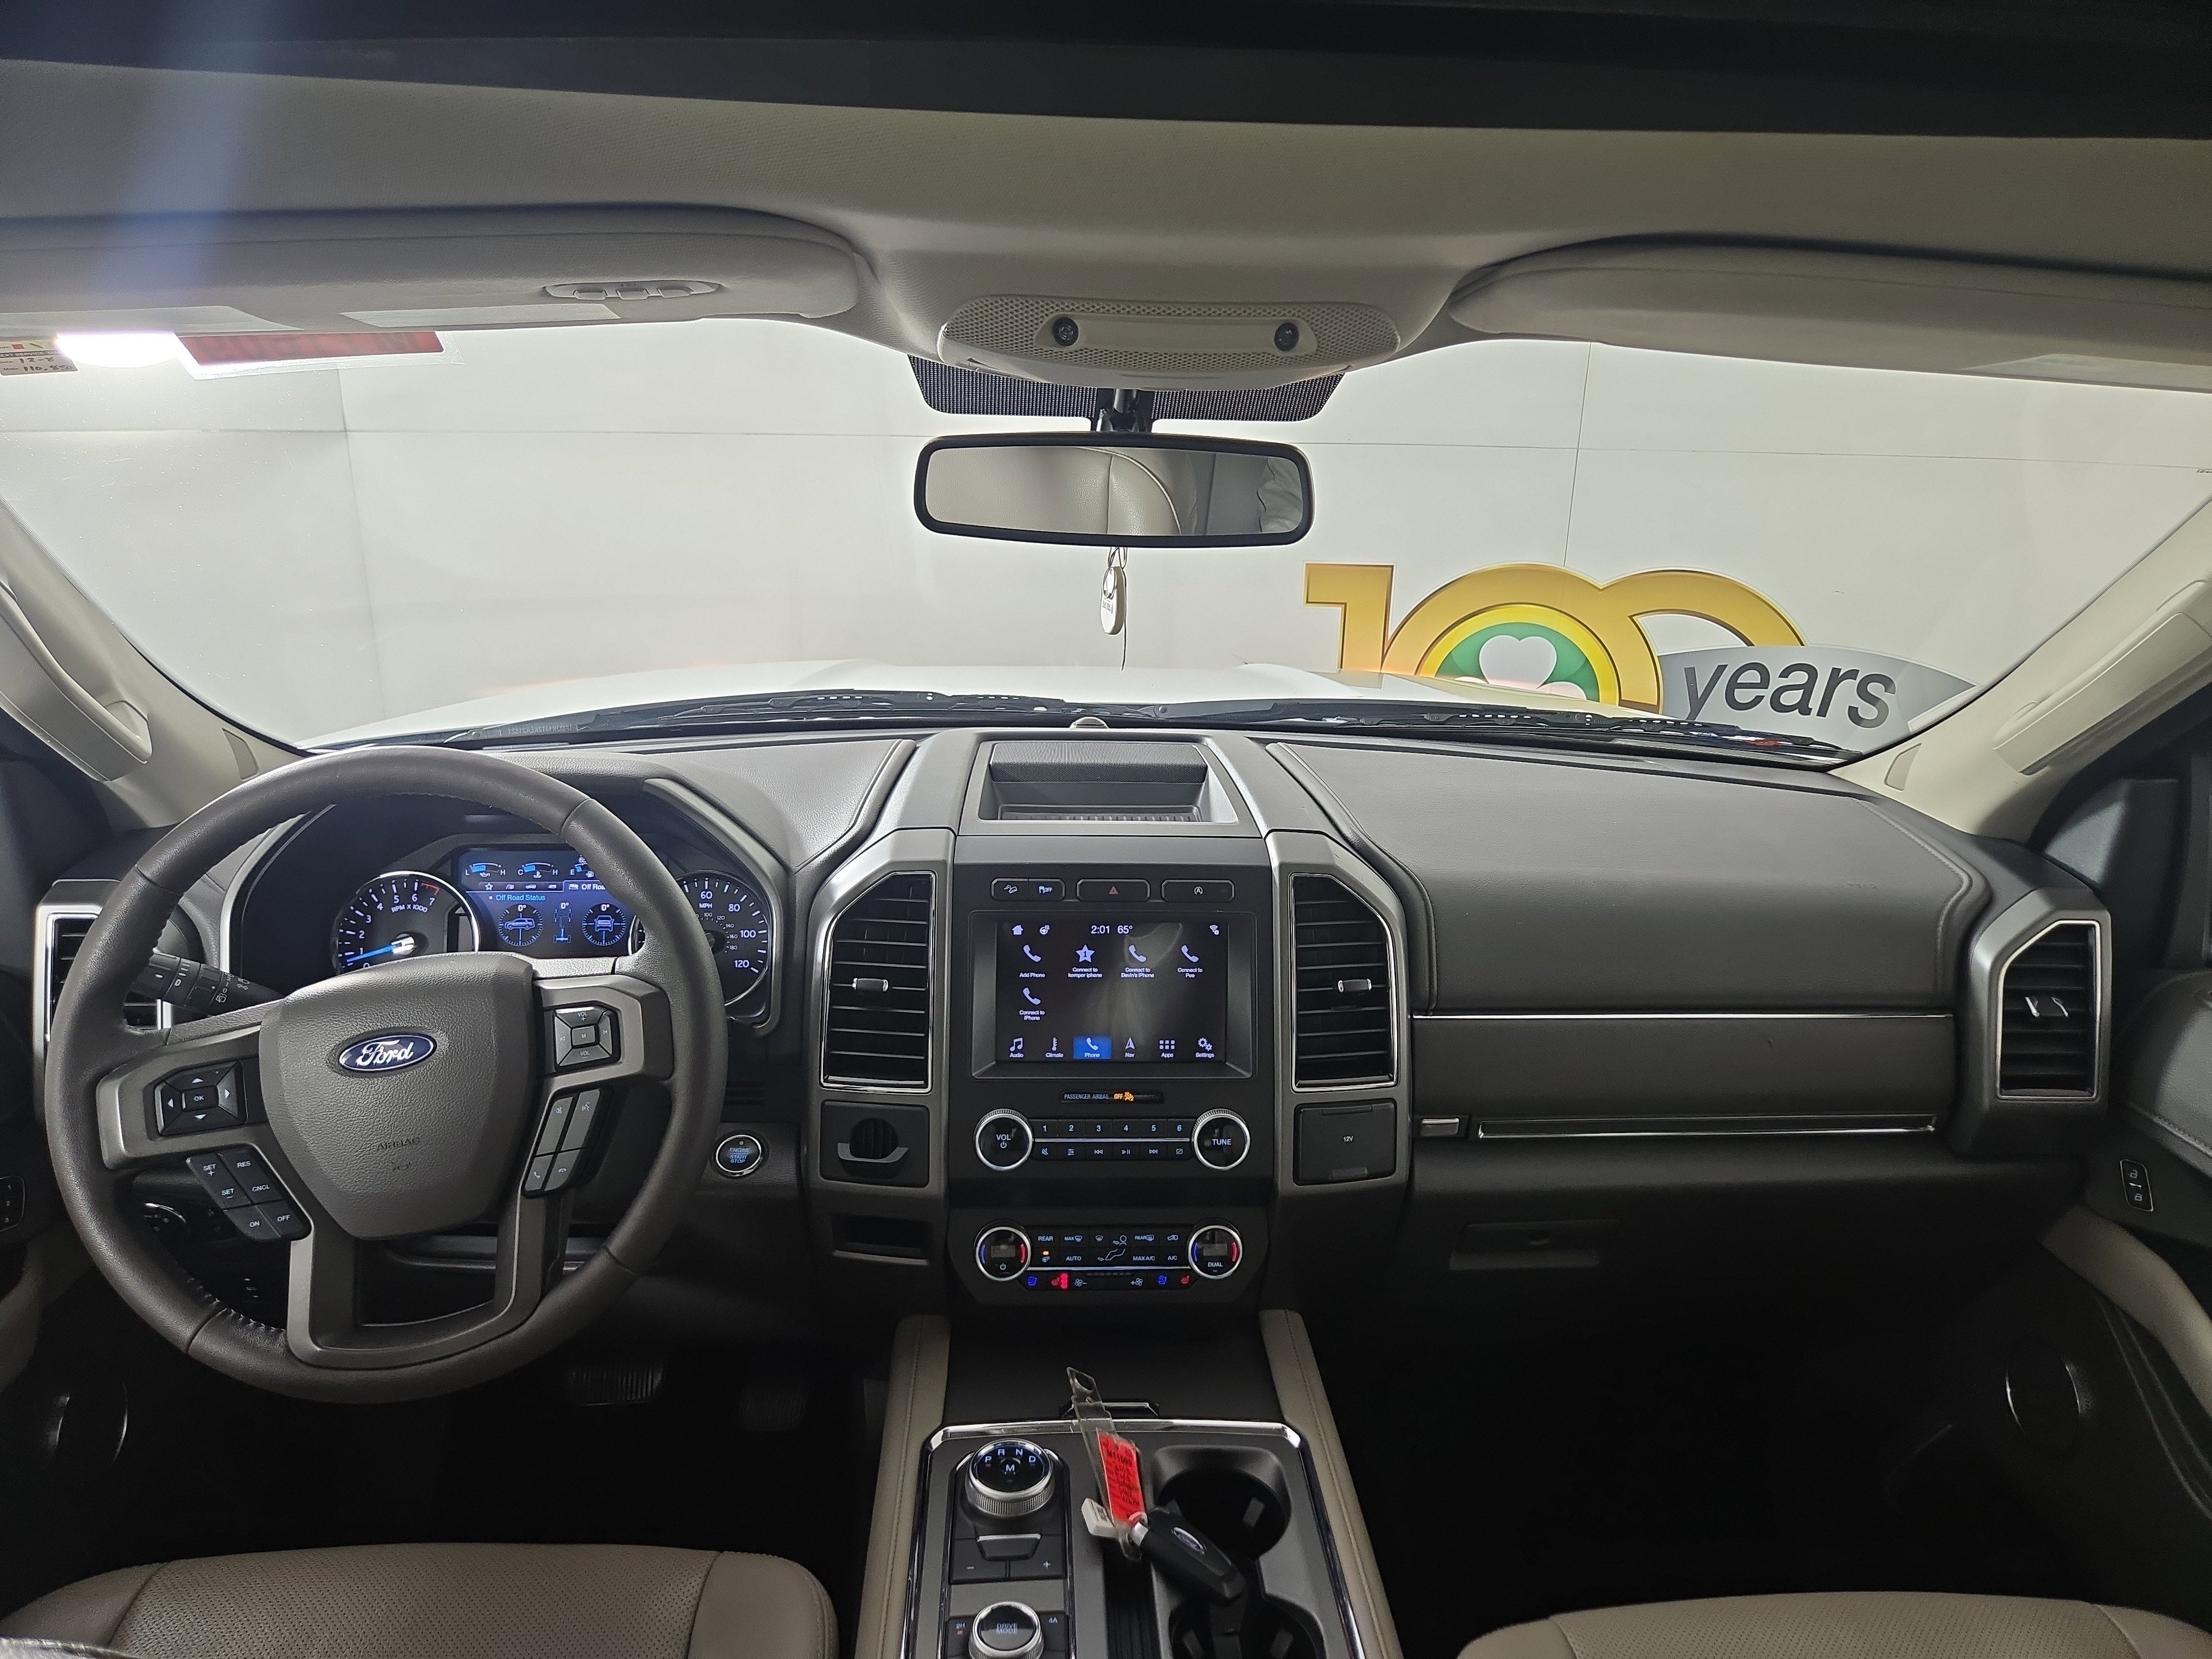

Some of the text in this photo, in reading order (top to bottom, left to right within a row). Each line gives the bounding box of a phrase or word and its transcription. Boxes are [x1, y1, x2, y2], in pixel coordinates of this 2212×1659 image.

[1304, 563, 1806, 712] 100
[1684, 662, 1896, 729] years
[394, 895, 400, 903] 5
[411, 893, 418, 902] 6
[700, 891, 712, 899] 60
[429, 898, 435, 906] 7
[377, 903, 383, 911] 4
[391, 904, 405, 913] RPM
[413, 904, 428, 912] 1000
[728, 903, 741, 912] 80
[365, 915, 371, 923] 3
[1091, 925, 1110, 934] 2:01
[1117, 925, 1133, 934] 65°
[359, 930, 364, 938] 2
[740, 930, 756, 938] 100
[735, 960, 749, 968] 120
[356, 1039, 414, 1066] Ford
[221, 1188, 235, 1196] SET
[252, 1184, 271, 1192] CNCL
[277, 1214, 291, 1223] OFF
[1006, 1464, 1015, 1472] M
